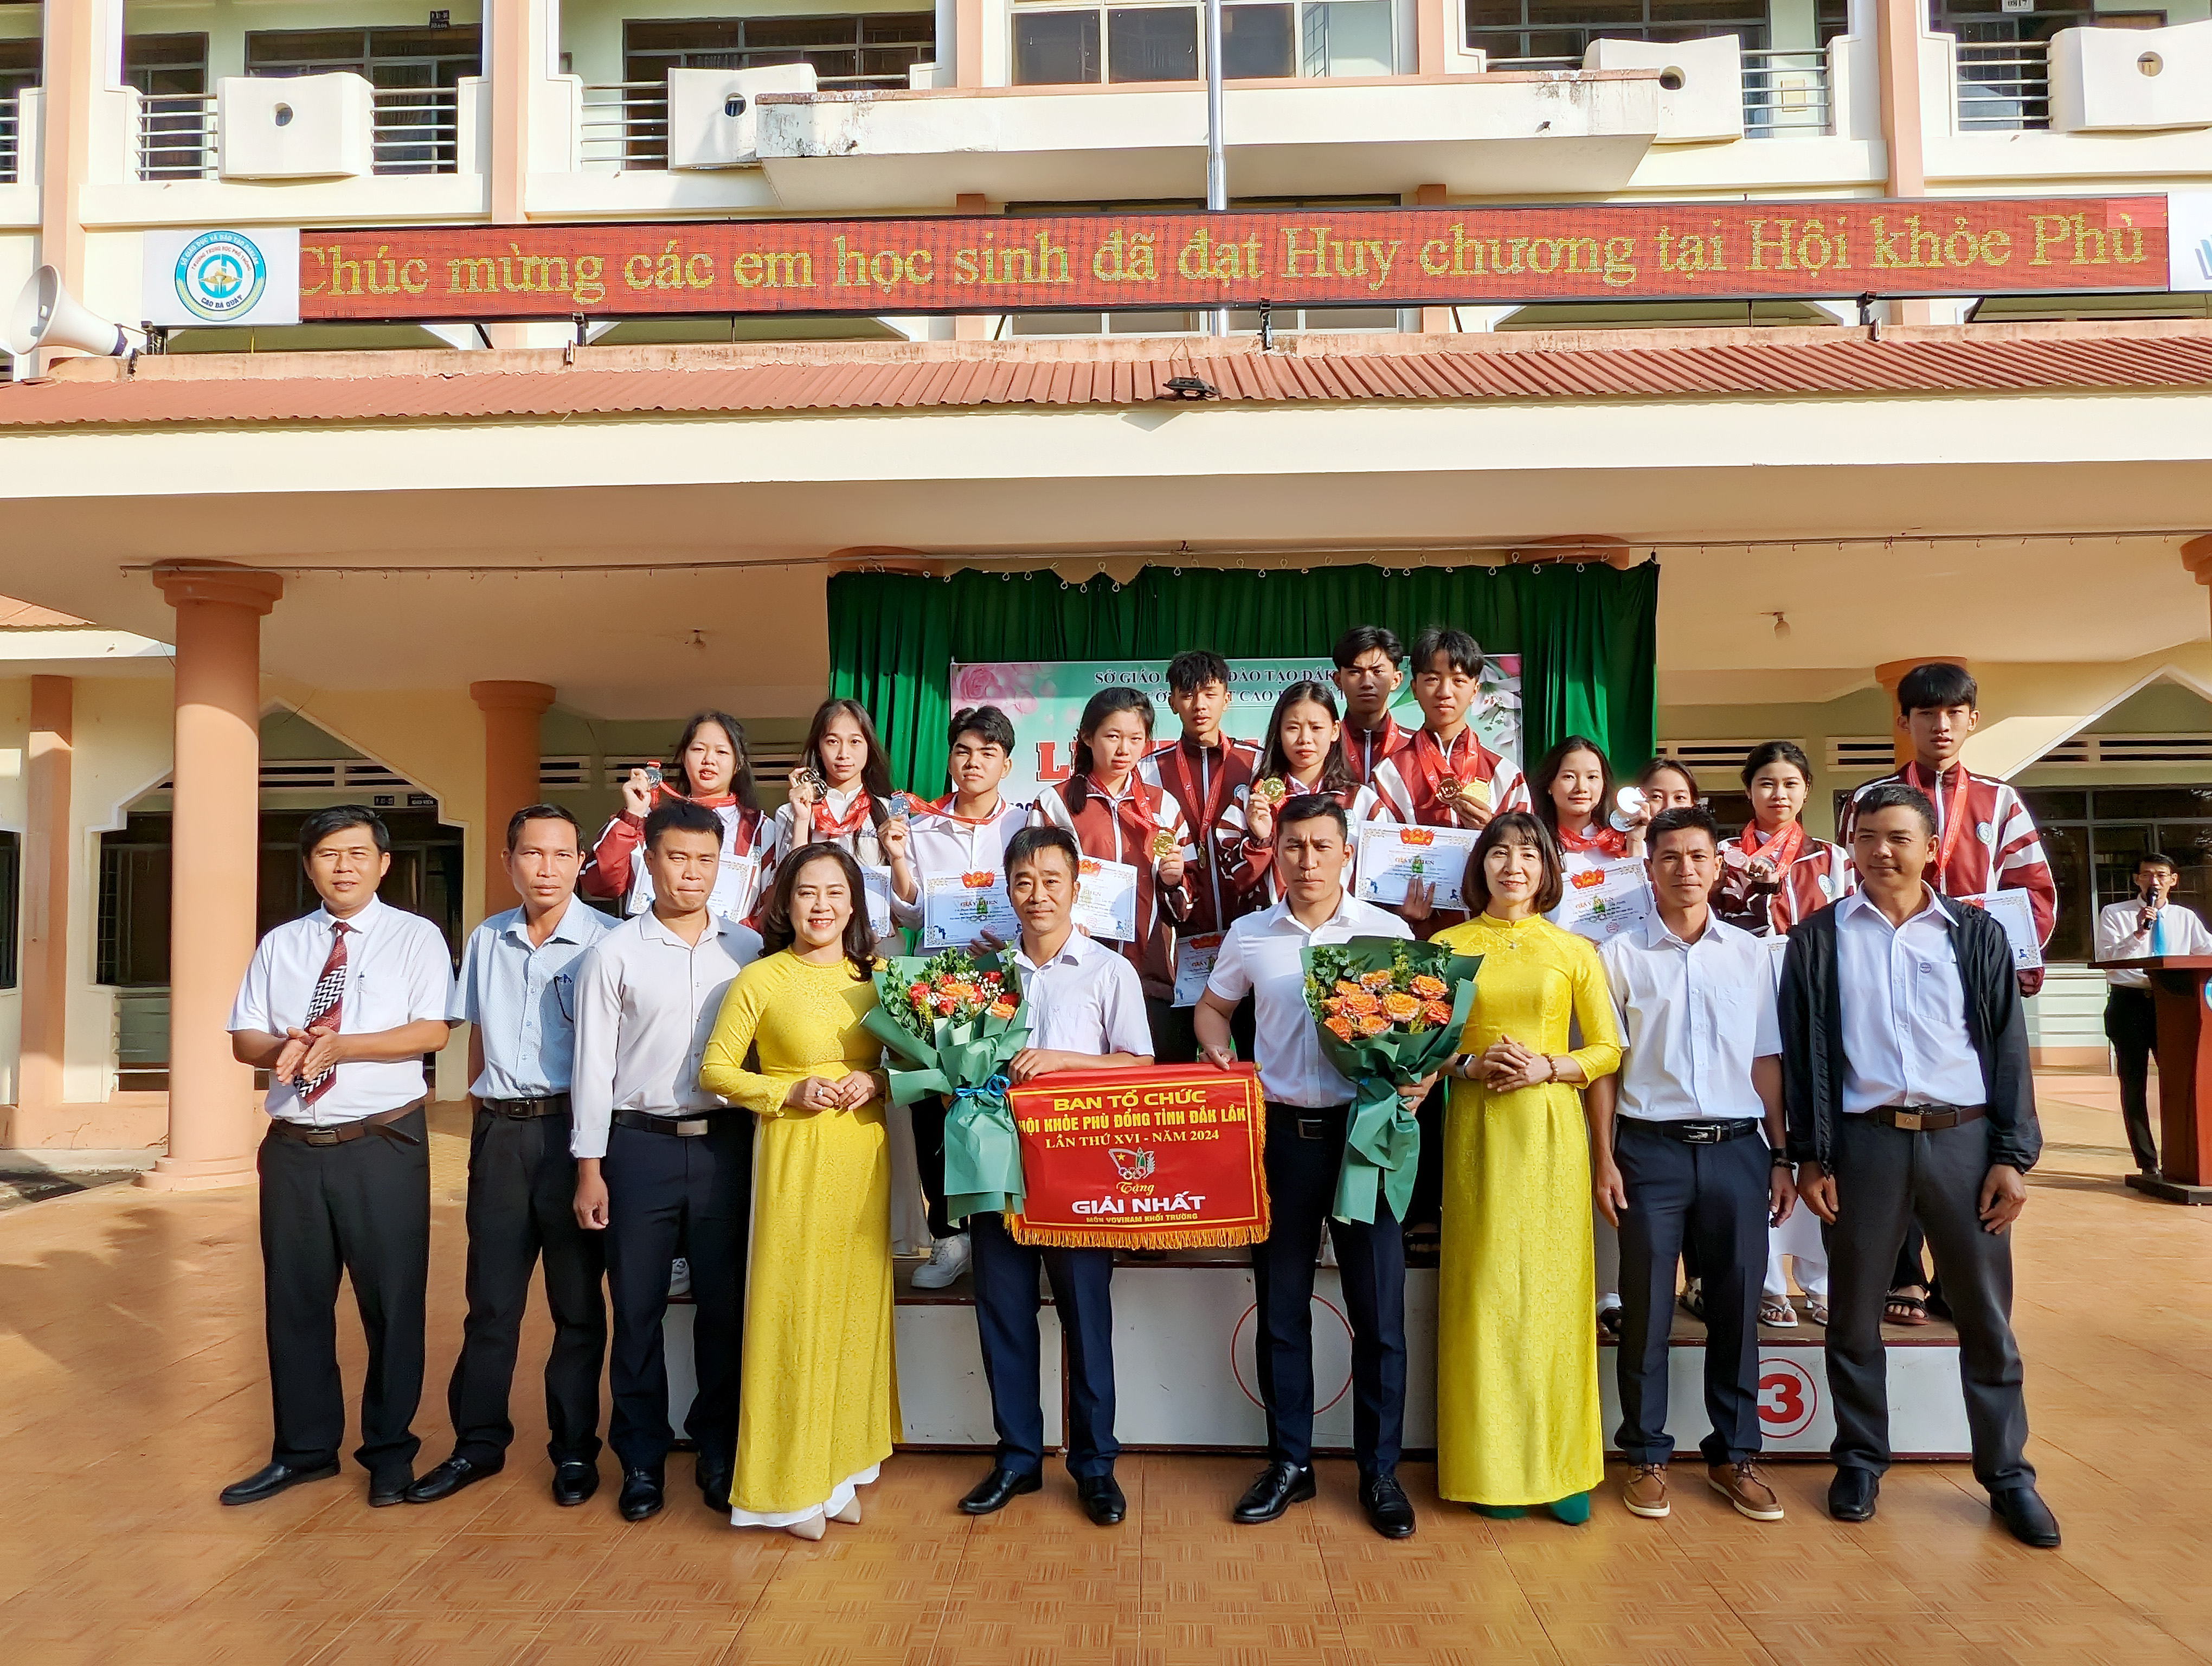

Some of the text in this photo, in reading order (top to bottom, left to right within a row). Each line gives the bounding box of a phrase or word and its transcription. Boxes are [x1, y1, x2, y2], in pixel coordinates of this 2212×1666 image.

[447, 242, 605, 305] mừng
[625, 240, 714, 290] các
[734, 251, 816, 287] em
[833, 234, 933, 294] học
[955, 231, 1073, 285] sinh
[1092, 228, 1159, 281] đã
[1178, 227, 1265, 287] đạt
[1280, 227, 1402, 290] Huy
[1419, 223, 1636, 286] chương
[1655, 218, 1727, 280] tại
[1745, 218, 1851, 278] Hội
[1869, 215, 2011, 268] khỏe
[2028, 213, 2147, 265] Phù
[201, 297, 214, 306] CAO
[1095, 669, 1116, 683] SỞ
[1120, 669, 1160, 683] GIÁO
[1264, 670, 1298, 684] TẠO
[1239, 690, 1273, 702] CAO
[1054, 1088, 1206, 1111] BAN TỔ CHỨC
[1044, 1114, 1079, 1132] KHỎE
[1083, 1113, 1109, 1130] PHÙ
[1114, 1108, 1150, 1127] ĐỔNG
[1154, 1108, 1185, 1125] TỈNH
[1189, 1105, 1217, 1124] ĐẮK
[1221, 1104, 1246, 1122] LẮK
[1046, 1134, 1075, 1148] LẦN
[1079, 1132, 1110, 1146] THỨ
[1114, 1133, 1140, 1144] XVI
[1152, 1130, 1186, 1142] NĂM
[1190, 1129, 1219, 1140] 2024
[1072, 1191, 1206, 1214] GIẢI NHẤT
[1106, 1215, 1142, 1223] VOVINAM
[1144, 1213, 1163, 1222] KHỐI
[1166, 1213, 1198, 1221] TRƯỜNG
[1757, 1373, 1804, 1424] 3
